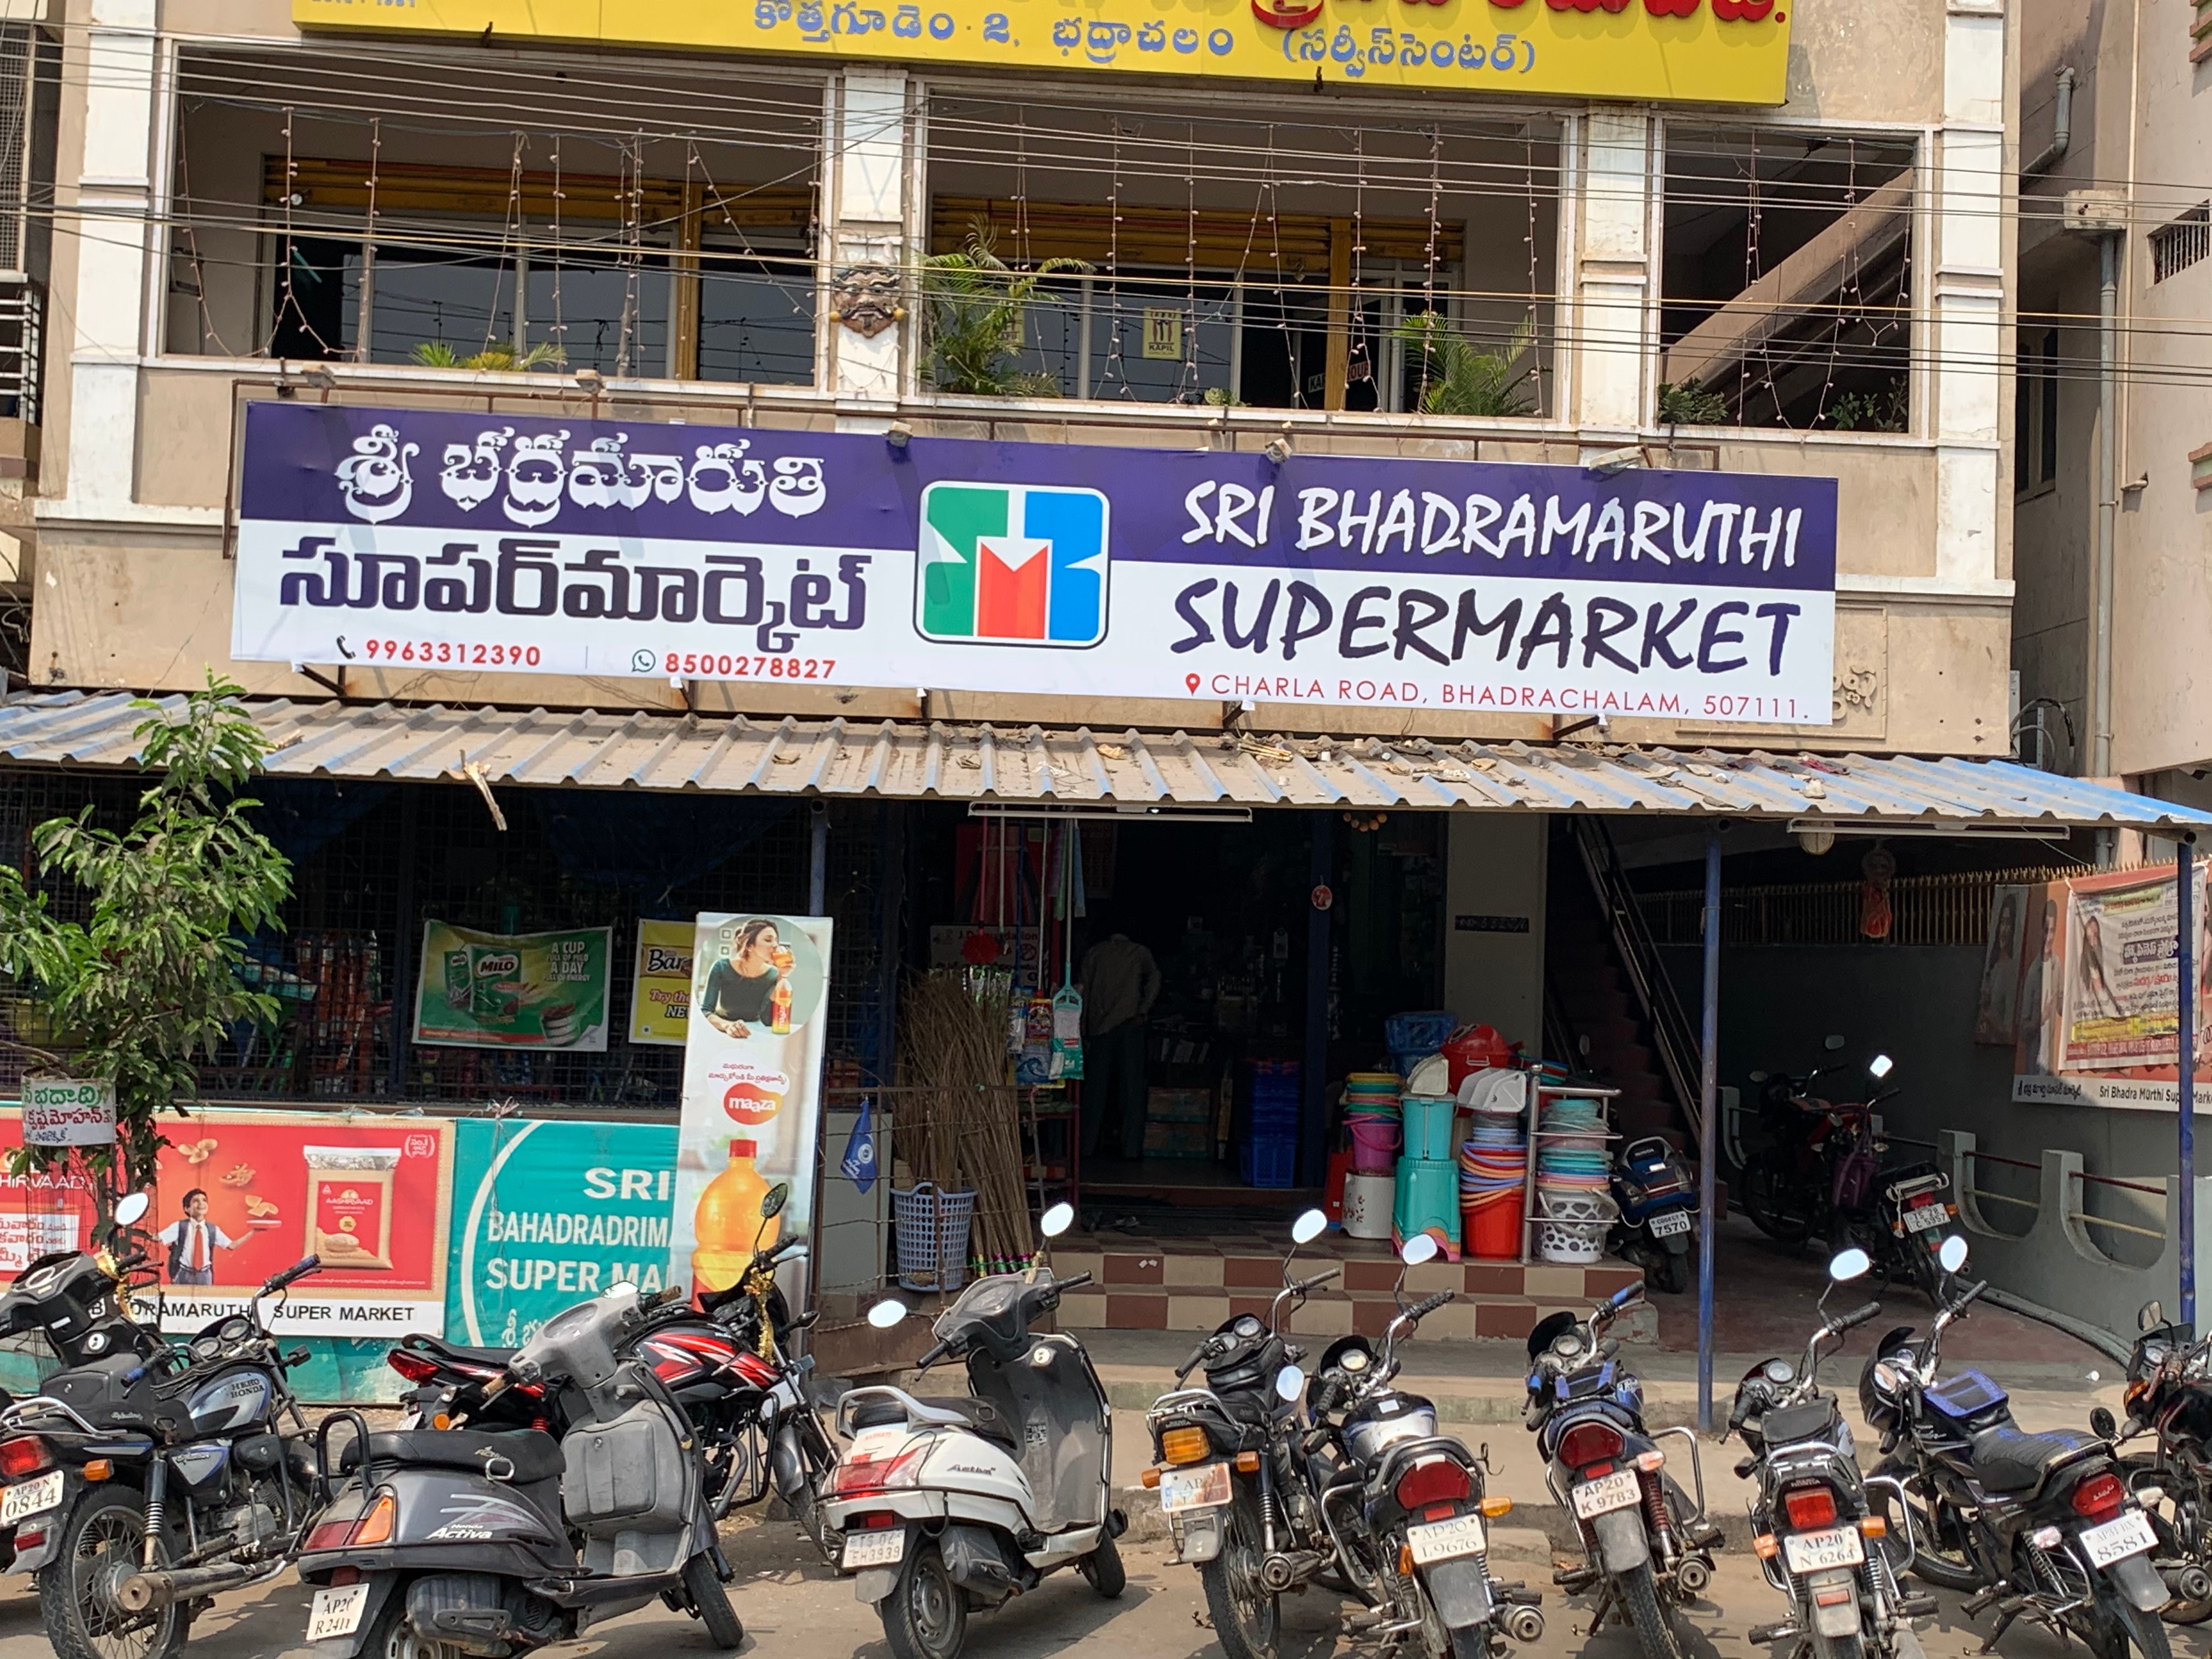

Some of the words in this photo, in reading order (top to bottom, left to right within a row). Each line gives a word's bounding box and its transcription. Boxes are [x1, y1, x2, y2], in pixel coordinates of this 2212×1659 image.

[1053, 19, 1234, 63] భద్రాచలం
[335, 424, 419, 524] శ్రీ
[441, 427, 825, 528] భద్రమారుతి
[1181, 481, 1272, 546] SRI
[1296, 487, 1803, 571] BHADRAMARUTHI
[1170, 577, 1801, 676] SUPERMARKET
[366, 639, 540, 667] 9963312390
[665, 652, 836, 679] 8500278827
[1212, 674, 1324, 699] CHARLA
[1338, 679, 1427, 705] ROAD,
[1442, 684, 1689, 715] BHADRACHALAM,
[1703, 693, 1809, 720] 507111.
[551, 942, 558, 954] A
[562, 941, 585, 954] CUP
[480, 961, 515, 972] MILO
[551, 963, 558, 974] A
[561, 962, 584, 974] DAY
[650, 989, 672, 1004] Try
[2100, 1085, 2109, 1098] Sri
[2112, 1087, 2137, 1100] Bhadra
[729, 1097, 776, 1113] maaza
[583, 1167, 670, 1201] SRI
[488, 1211, 670, 1248] BAHADRADRIM
[1655, 1221, 1688, 1235] 7570
[486, 1257, 601, 1293] SUPER
[273, 1305, 331, 1319] SUPER
[340, 1306, 415, 1322] MARKET
[230, 1385, 265, 1398] HONDA
[14, 1481, 40, 1497] AP20
[1585, 1477, 1624, 1498] AP20
[5, 1487, 57, 1517] 0844
[1581, 1500, 1593, 1514] K
[1596, 1488, 1635, 1509] 9783
[425, 1527, 493, 1540] Activa
[1803, 1533, 1843, 1551] AP20
[2097, 1532, 2148, 1561] 8581
[1799, 1555, 1812, 1569] N
[1819, 1548, 1855, 1565] 6264
